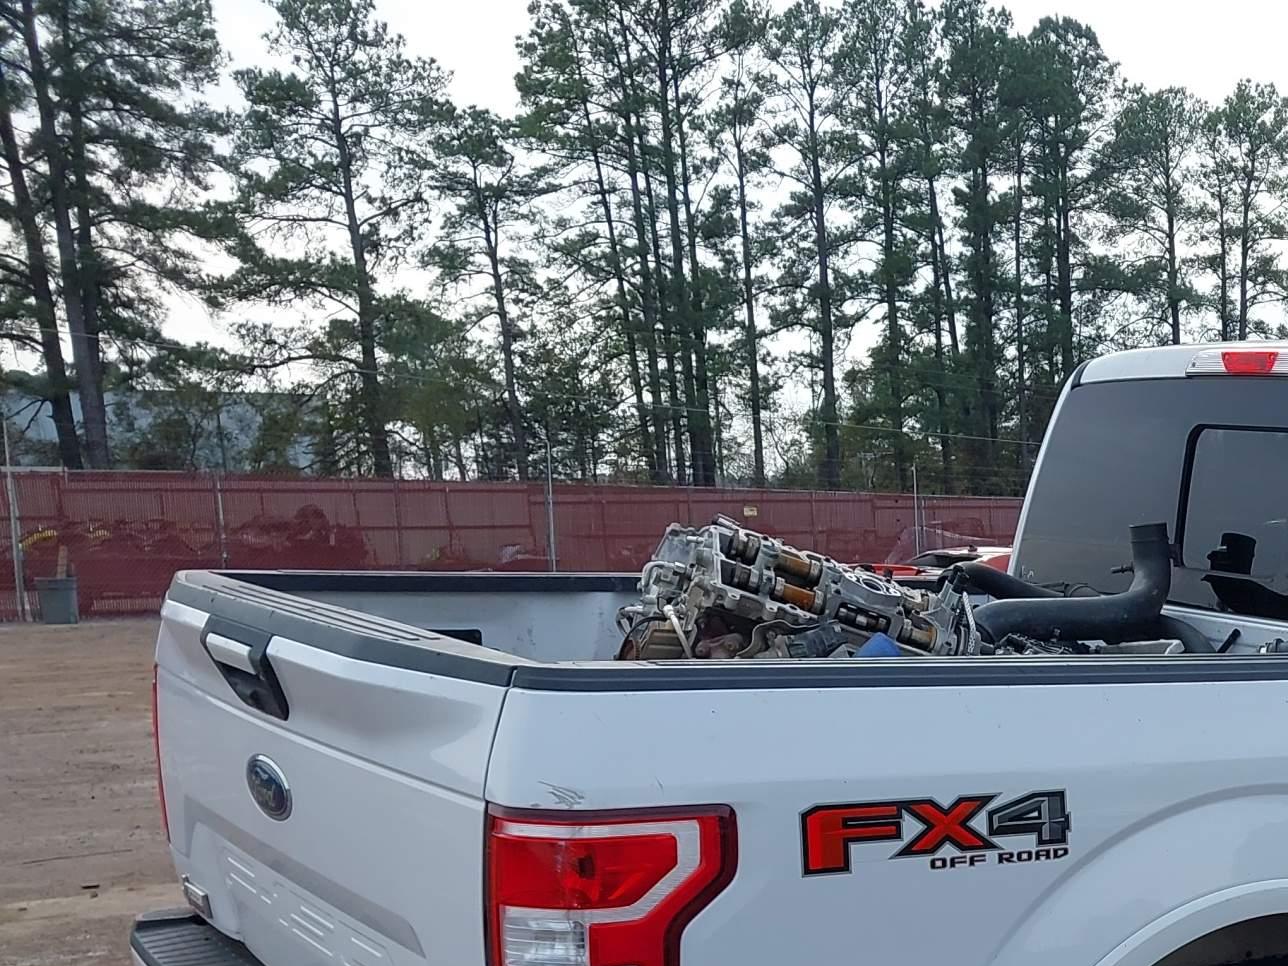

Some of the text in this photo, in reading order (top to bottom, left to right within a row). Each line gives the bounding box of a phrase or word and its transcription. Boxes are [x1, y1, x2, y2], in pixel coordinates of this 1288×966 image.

[799, 789, 1071, 877] FX4
[930, 846, 1069, 870] OFF ROAD
